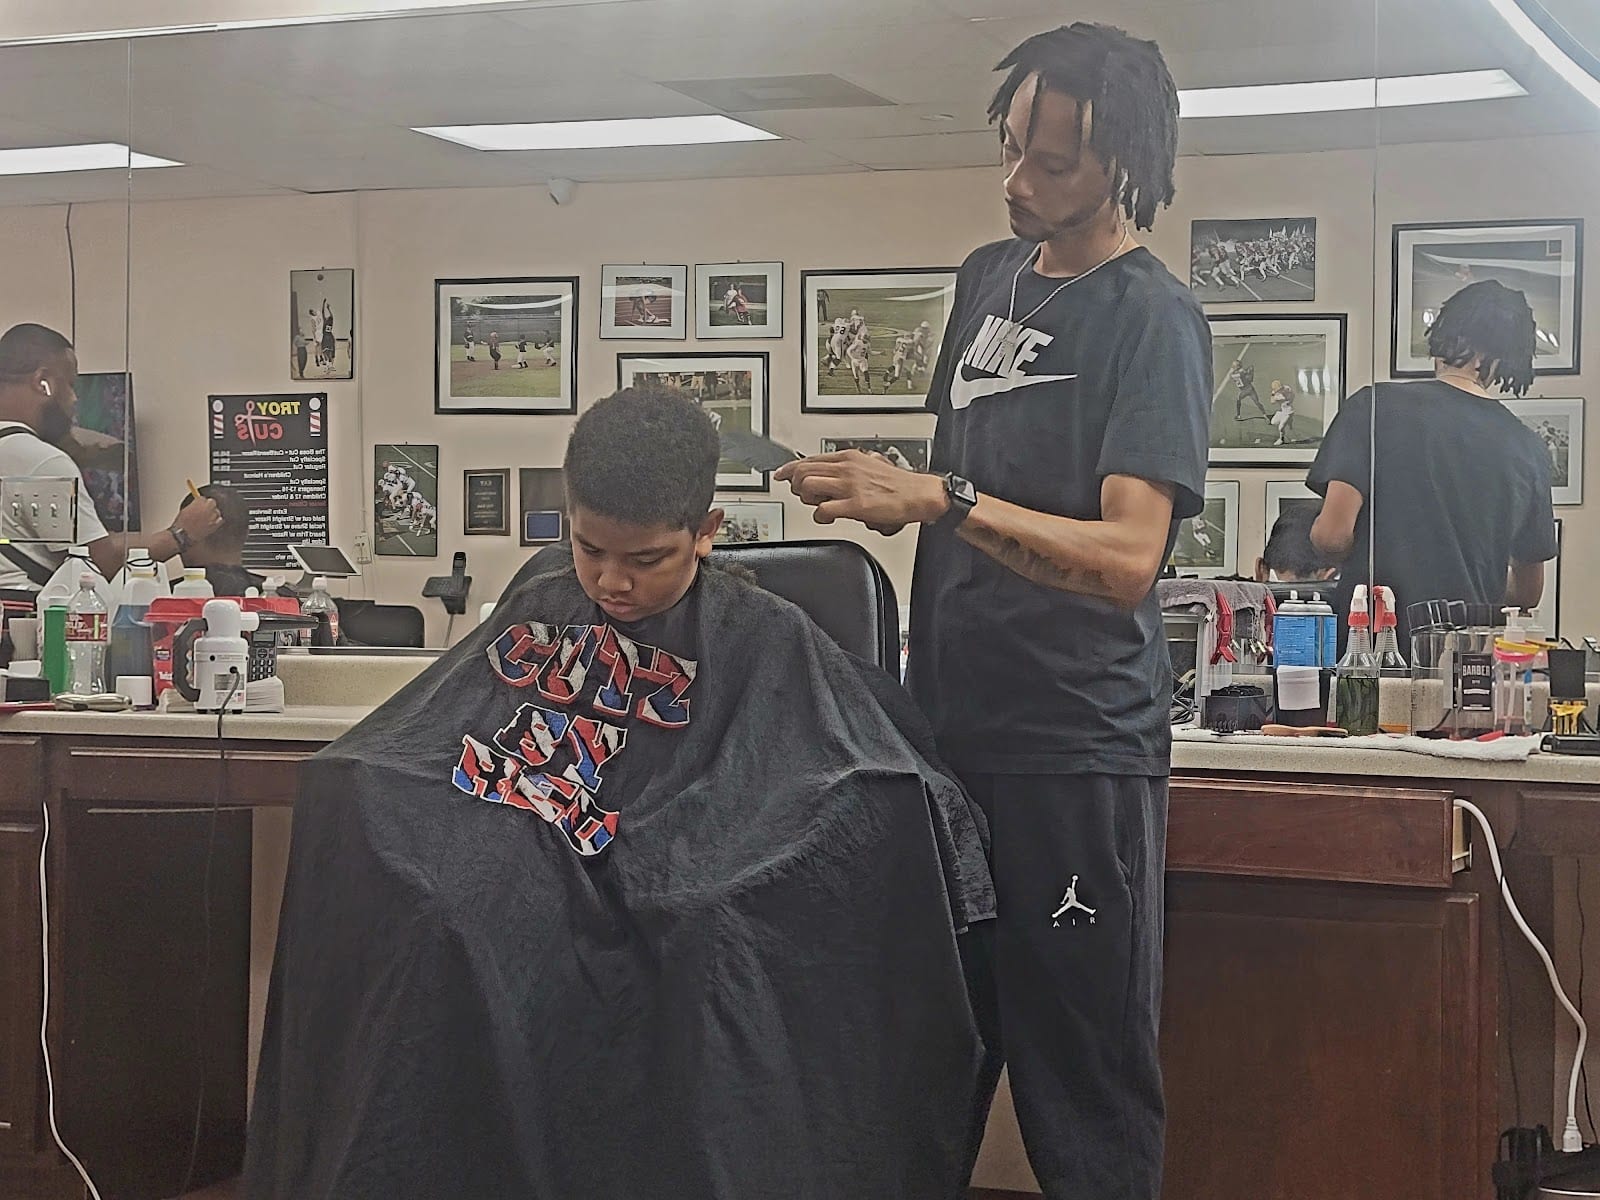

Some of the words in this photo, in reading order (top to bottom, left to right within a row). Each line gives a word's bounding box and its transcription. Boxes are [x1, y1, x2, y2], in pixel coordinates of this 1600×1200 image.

[964, 314, 1055, 379] NIKE
[485, 621, 698, 730] CUTZ
[1462, 665, 1491, 677] BARBER
[492, 701, 628, 794] BY
[1052, 916, 1096, 929] AIR
